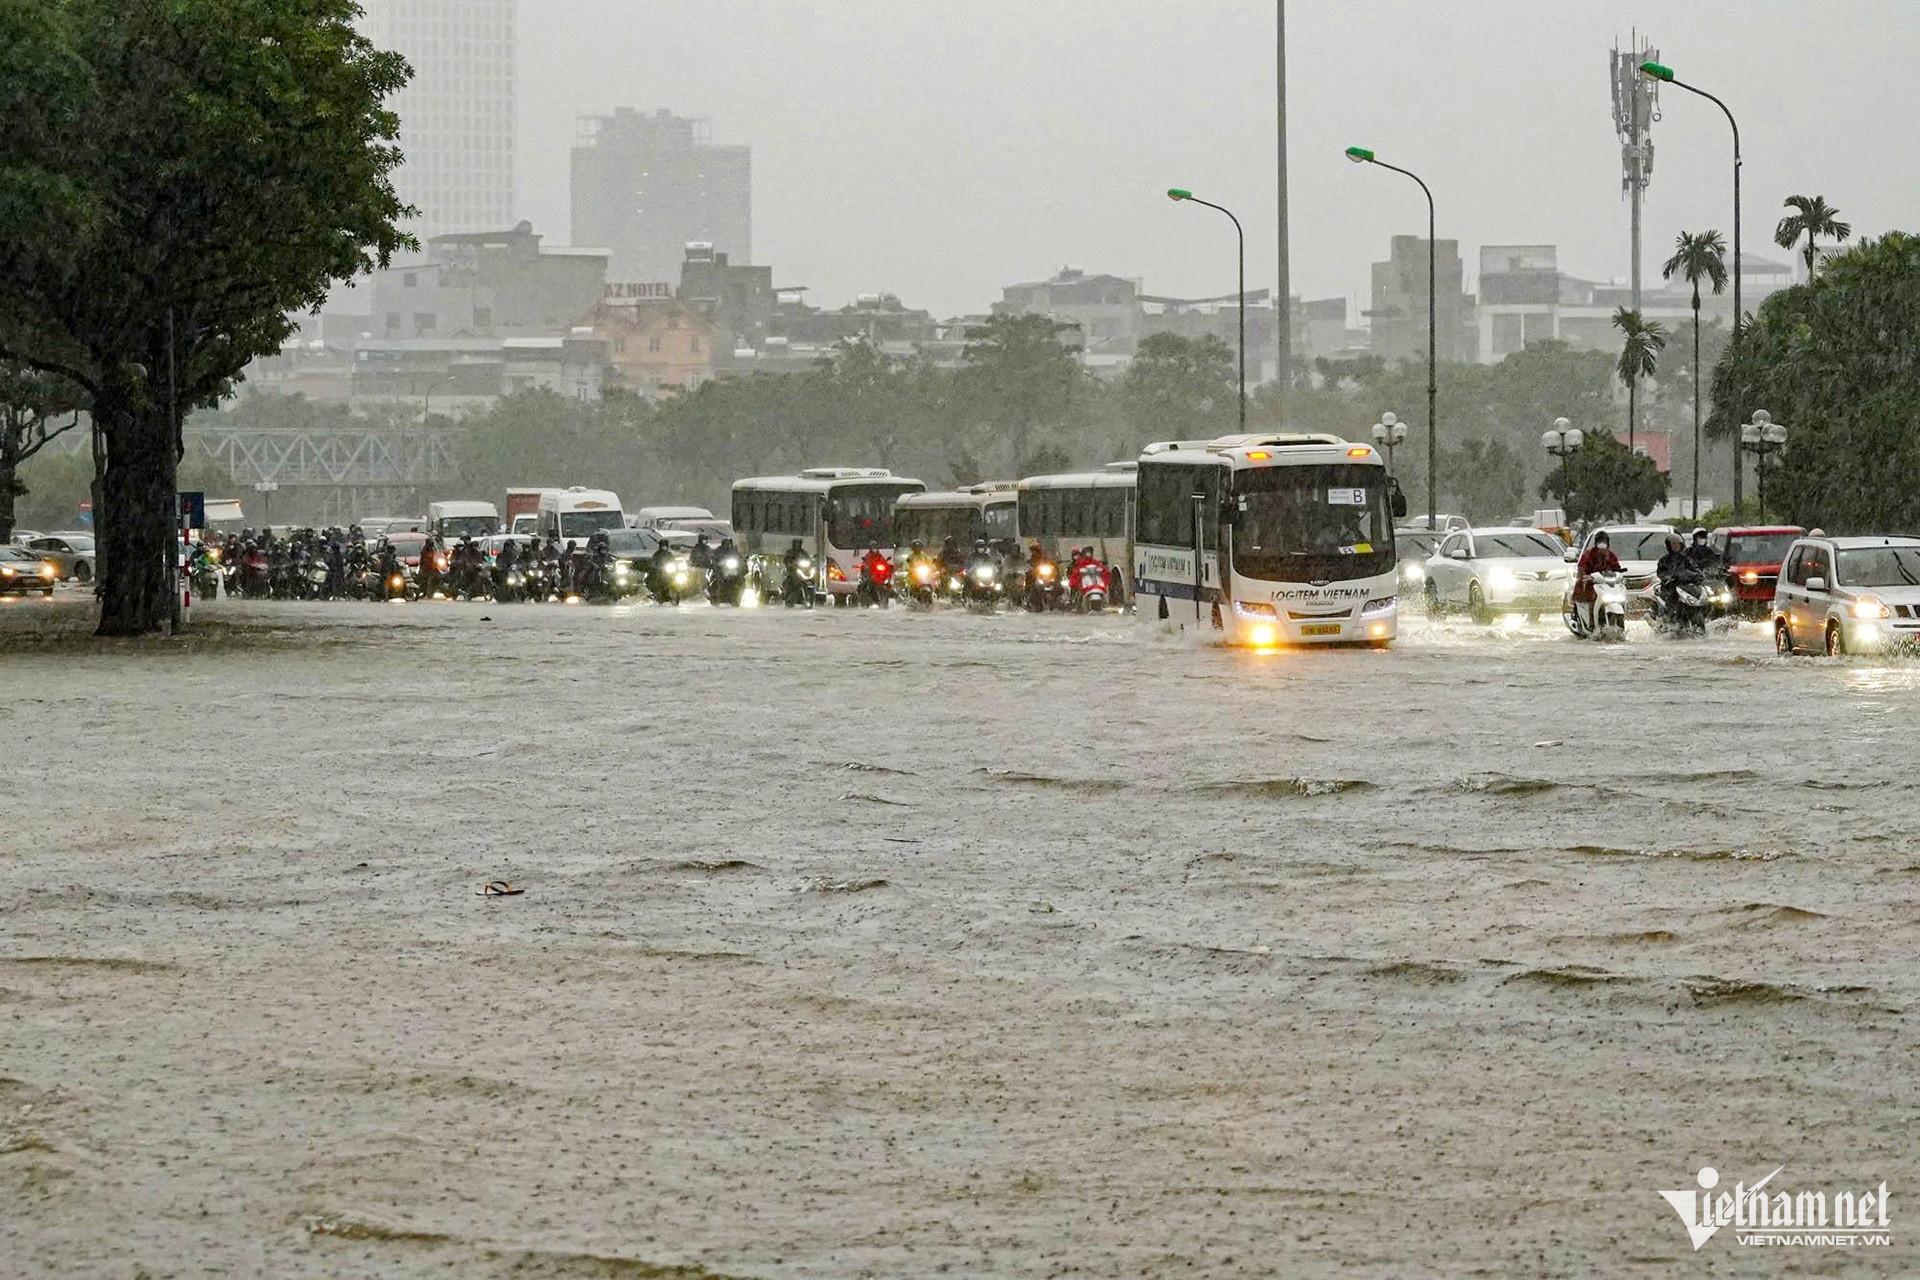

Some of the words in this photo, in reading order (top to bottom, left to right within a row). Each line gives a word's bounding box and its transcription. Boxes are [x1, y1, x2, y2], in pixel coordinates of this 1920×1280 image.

[627, 282, 672, 298] HOTEL
[1353, 490, 1362, 503] B
[1271, 590, 1320, 600] LOGITEM
[1323, 588, 1370, 600] VIETNAM
